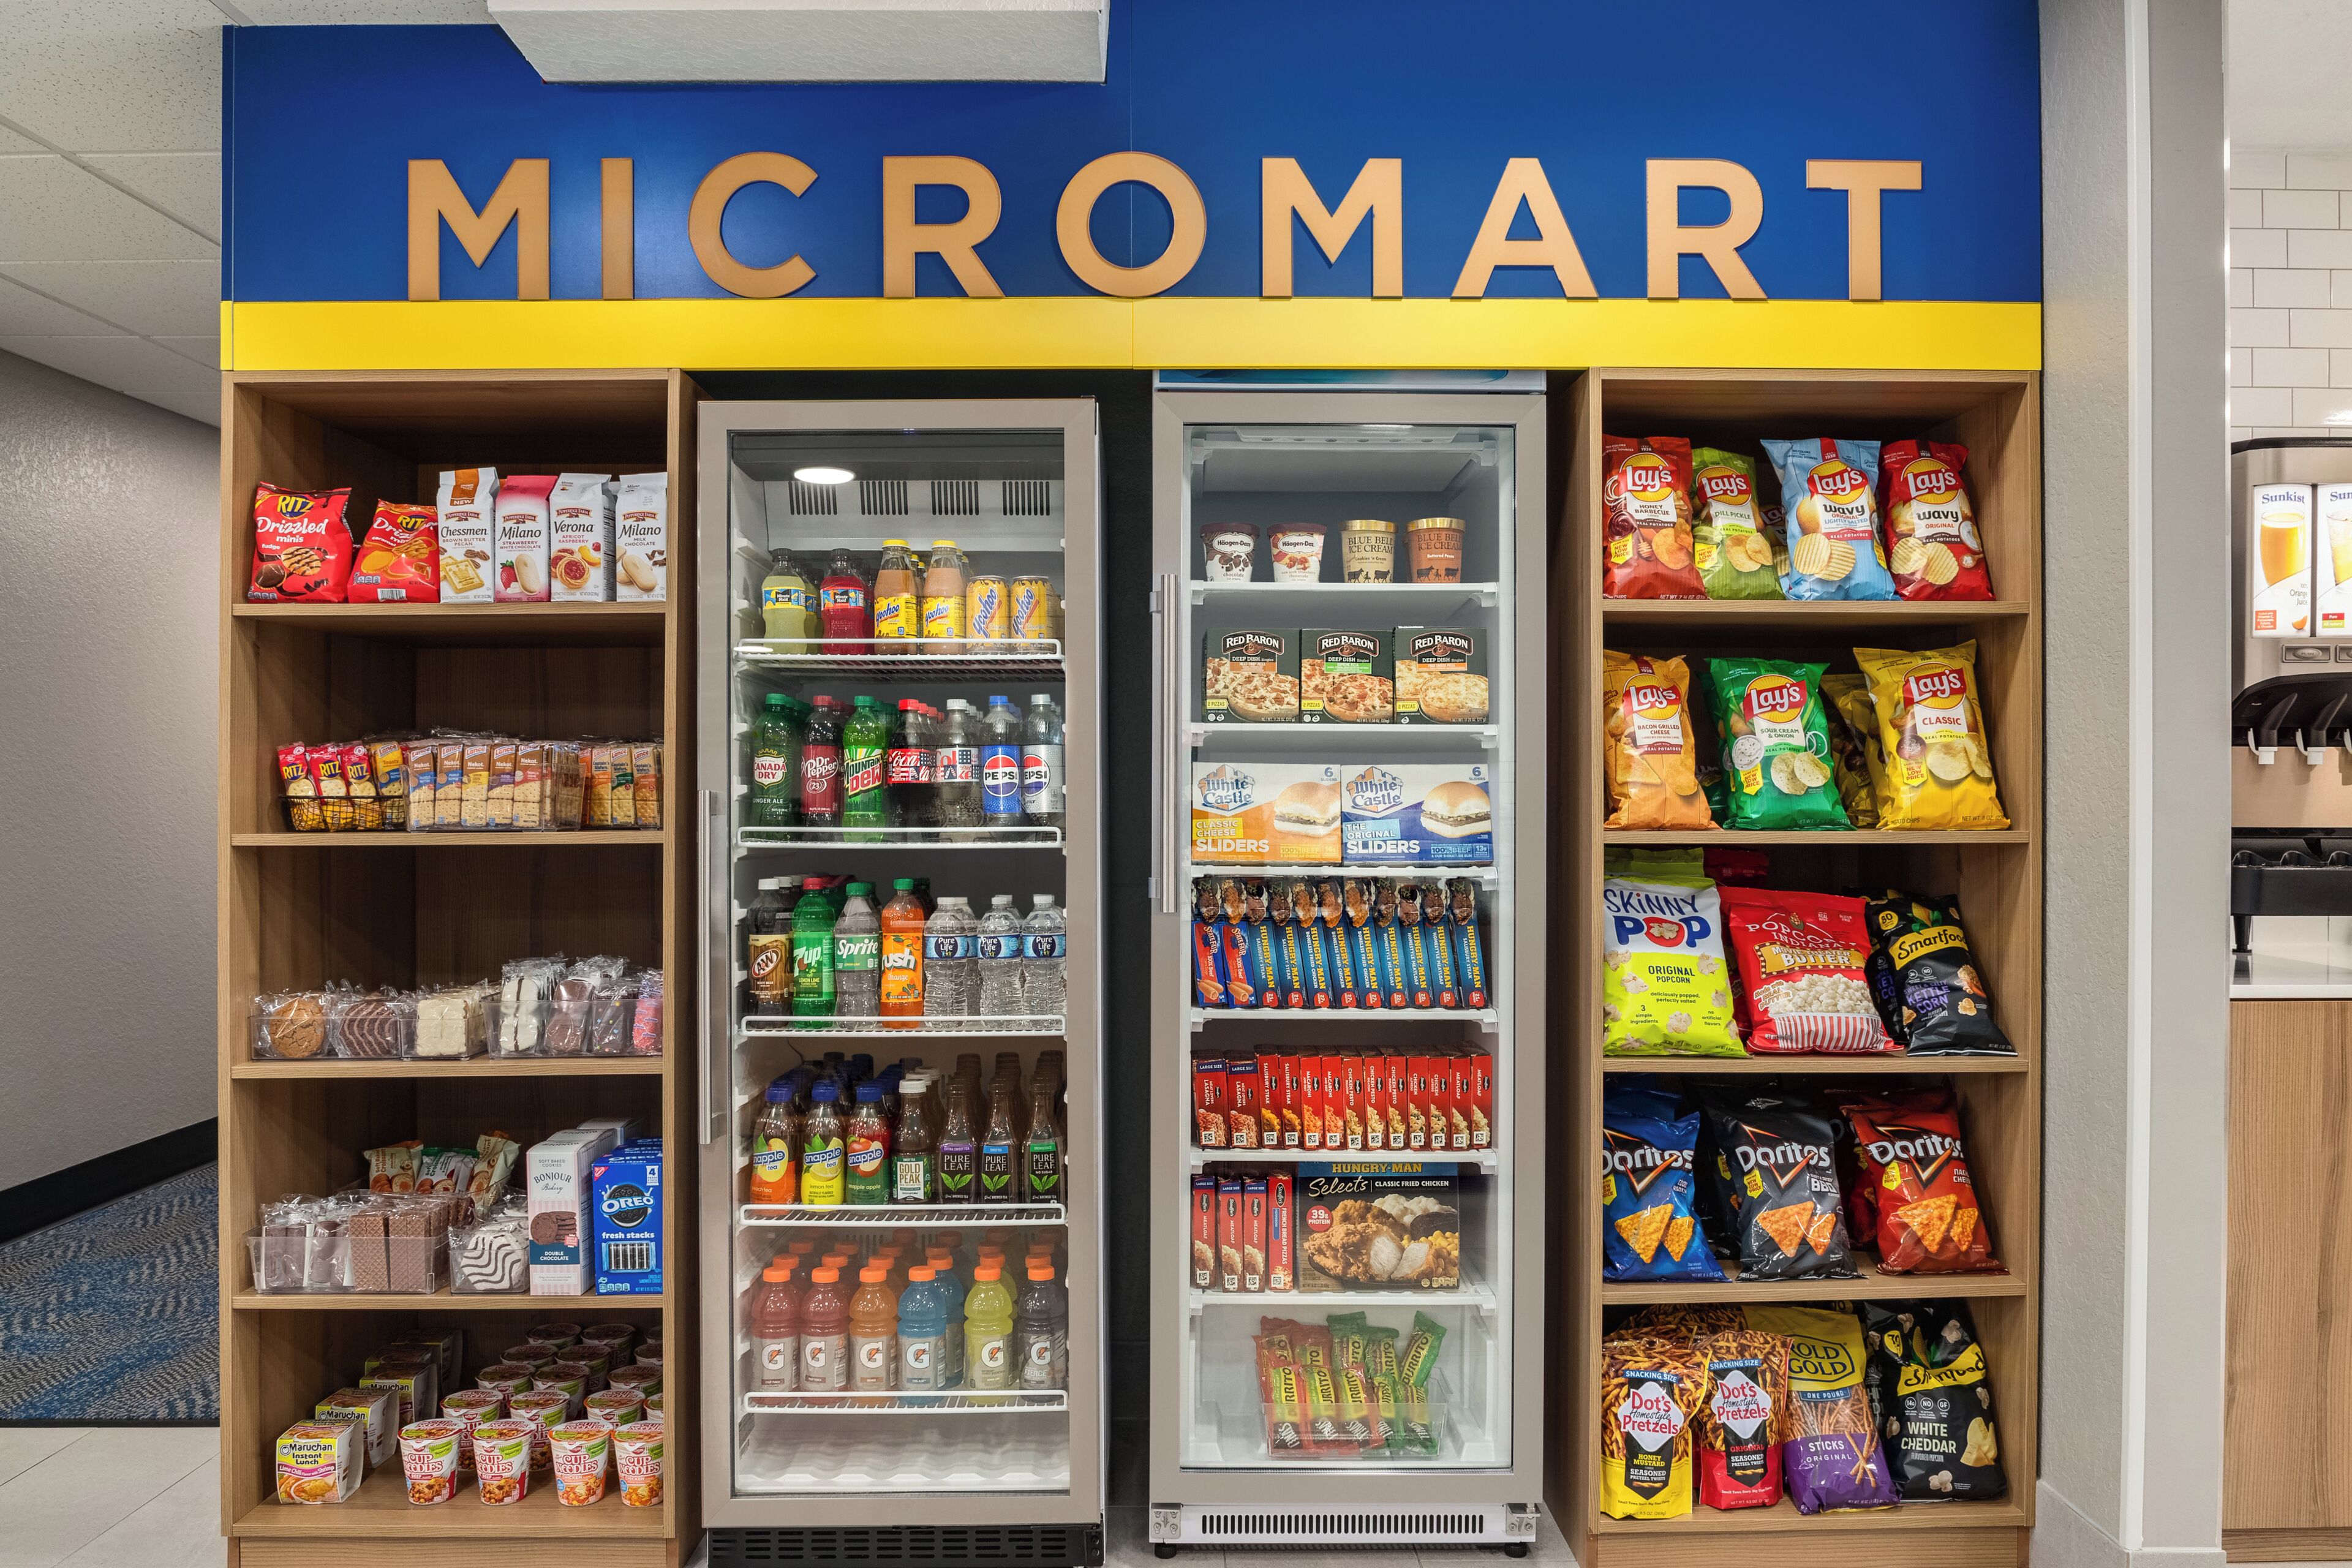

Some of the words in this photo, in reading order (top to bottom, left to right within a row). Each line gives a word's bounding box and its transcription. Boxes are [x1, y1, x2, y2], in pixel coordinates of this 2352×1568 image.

[408, 151, 1922, 301] MICROMART
[1626, 466, 1673, 492] Lay's
[1701, 473, 1747, 498] Lay's
[1813, 467, 1863, 496] Lay's
[277, 494, 315, 513] RITZ
[2261, 491, 2305, 505] Sunkist
[1823, 503, 1866, 516] wavy
[1917, 510, 1959, 522] wavy
[257, 516, 329, 535] Drizzled
[441, 526, 487, 537] Chessmen
[554, 521, 594, 534] Verona
[618, 524, 662, 540] Milano
[276, 535, 304, 543] minis
[498, 526, 541, 541] Milano
[1348, 537, 1373, 545] BLUE
[1375, 536, 1394, 545] BELL
[1349, 545, 1362, 554] ICE
[1364, 545, 1393, 554] CREAM
[2290, 589, 2308, 599] Orange
[1226, 638, 1244, 647] RED
[1246, 635, 1280, 648] BARON
[1322, 638, 1340, 647] RED
[1341, 635, 1374, 648] BARON
[1415, 638, 1432, 647] RED
[1434, 635, 1468, 649] BARON
[1908, 669, 1962, 703] Lay's
[1751, 683, 1801, 715] Lay's
[1922, 717, 1962, 726] CLASSIC
[379, 744, 398, 756] Lance
[466, 745, 487, 758] Lance
[318, 760, 342, 776] RITZ
[753, 763, 786, 772] CANADA
[816, 756, 829, 766] Dr
[283, 764, 305, 780] RITZ
[758, 771, 777, 780] DRY
[805, 760, 837, 778] Pepper
[985, 772, 1019, 782] PEPSI
[1205, 778, 1250, 792] White
[1354, 779, 1396, 793] White
[1203, 791, 1252, 805] Castle
[1351, 792, 1401, 807] Castle
[1196, 820, 1238, 829] CLASSIC
[1196, 828, 1236, 837] CHEESE
[1348, 830, 1395, 839] ORIGINAL
[1196, 839, 1270, 853] SLIDERS
[1346, 839, 1420, 854] SLIDERS
[938, 937, 956, 945] Pure
[837, 939, 878, 958] Sprite
[1259, 925, 1275, 989] HUNGRY-MAN
[1310, 926, 1326, 989] HUNGRY-MAN
[1467, 925, 1482, 989] HUNGRY-MAN
[1781, 952, 1851, 967] BUTTER
[1648, 965, 1695, 977] ORIGINAL
[1907, 986, 1950, 1005] KETTLE
[1915, 995, 1949, 1014] CORN
[805, 1147, 842, 1164] snapple
[848, 1148, 883, 1165] snapple
[1735, 1143, 1831, 1172] Doritos
[648, 1167, 657, 1176] 4
[899, 1164, 921, 1174] GOLD
[1332, 1163, 1422, 1173] HUNGRY-MAN
[533, 1172, 572, 1184] BONJOUR
[899, 1174, 921, 1184] PEAK
[541, 1184, 564, 1194] Bakery
[1309, 1177, 1369, 1197] Selects
[601, 1196, 654, 1213] OREO
[761, 1343, 785, 1370] G
[981, 1340, 1005, 1368] G
[1788, 1359, 1847, 1375] GOLD
[1626, 1371, 1662, 1379] SNACKING
[1663, 1374, 1677, 1382] SIZE
[1719, 1382, 1757, 1400] Dot's
[1631, 1392, 1671, 1412] Dot's
[327, 1411, 366, 1420] Maruchan
[1629, 1408, 1672, 1424] Homestyle
[1623, 1418, 1679, 1435] Pretzels
[1907, 1421, 1948, 1438] WHITE
[289, 1443, 334, 1453] Maruchan
[1808, 1440, 1844, 1452] STICKS
[1901, 1437, 1956, 1453] CHEDDAR
[408, 1453, 433, 1464] CUP
[479, 1454, 504, 1464] CUP
[562, 1455, 590, 1465] CUP
[1806, 1452, 1852, 1463] ORIGINAL
[317, 1465, 335, 1474] Shrimp
[556, 1461, 598, 1474] NOODLES
[1630, 1468, 1666, 1477] SEASONED
